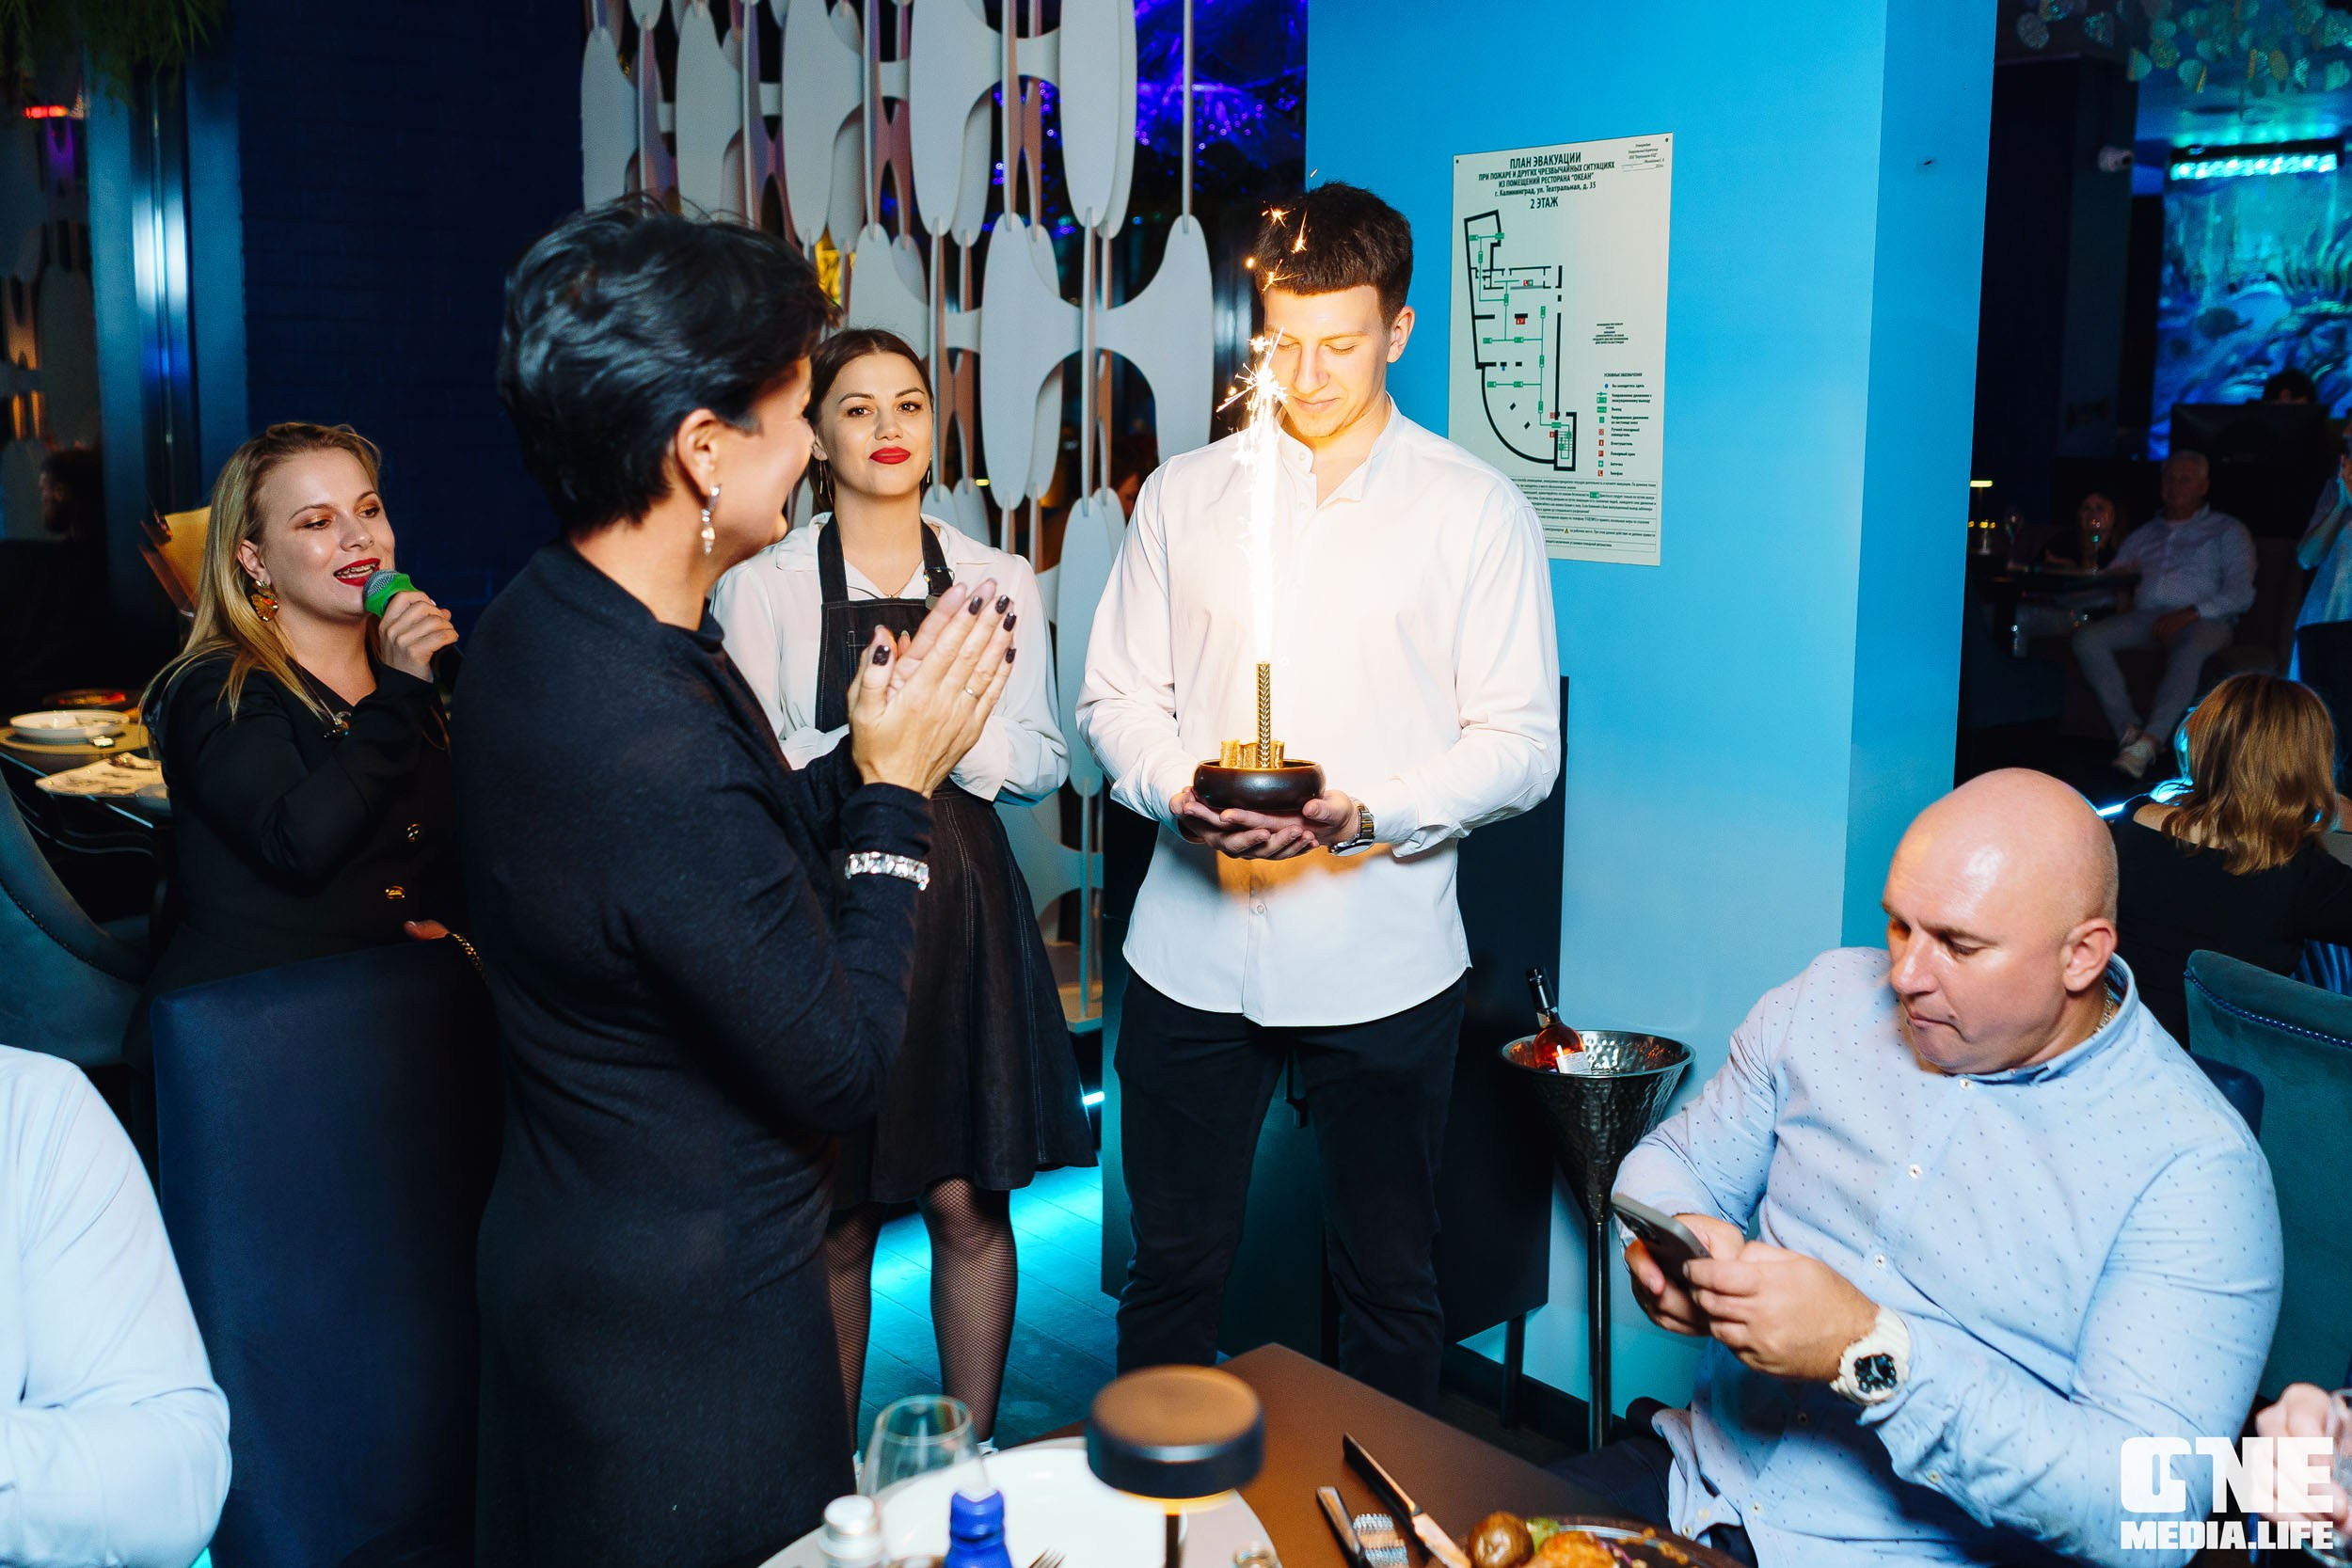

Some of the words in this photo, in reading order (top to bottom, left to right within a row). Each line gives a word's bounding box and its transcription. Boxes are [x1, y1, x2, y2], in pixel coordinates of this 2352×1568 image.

[1510, 157, 1532, 169] ПЛАН
[1534, 151, 1581, 167] ЭВАКУАЦИИ
[1490, 170, 1512, 180] ПОЖАРЕ
[1518, 168, 1537, 179] ДРУГИХ
[1537, 164, 1582, 176] ЧРЕЗВЫЧАЙНЫХ
[1583, 161, 1615, 172] СИТУАЦИЯХ
[1499, 180, 1505, 188] ИЗ
[1506, 176, 1540, 187] ПОМЕЩЕНИЙ
[1541, 174, 1570, 184] РЕСТОРАНА
[1500, 188, 1535, 197] Калининград,
[1546, 184, 1581, 194] Театральная,
[1589, 181, 1597, 189] 35
[1530, 198, 1535, 209] 2
[1536, 196, 1559, 209] ЭТАЖ
